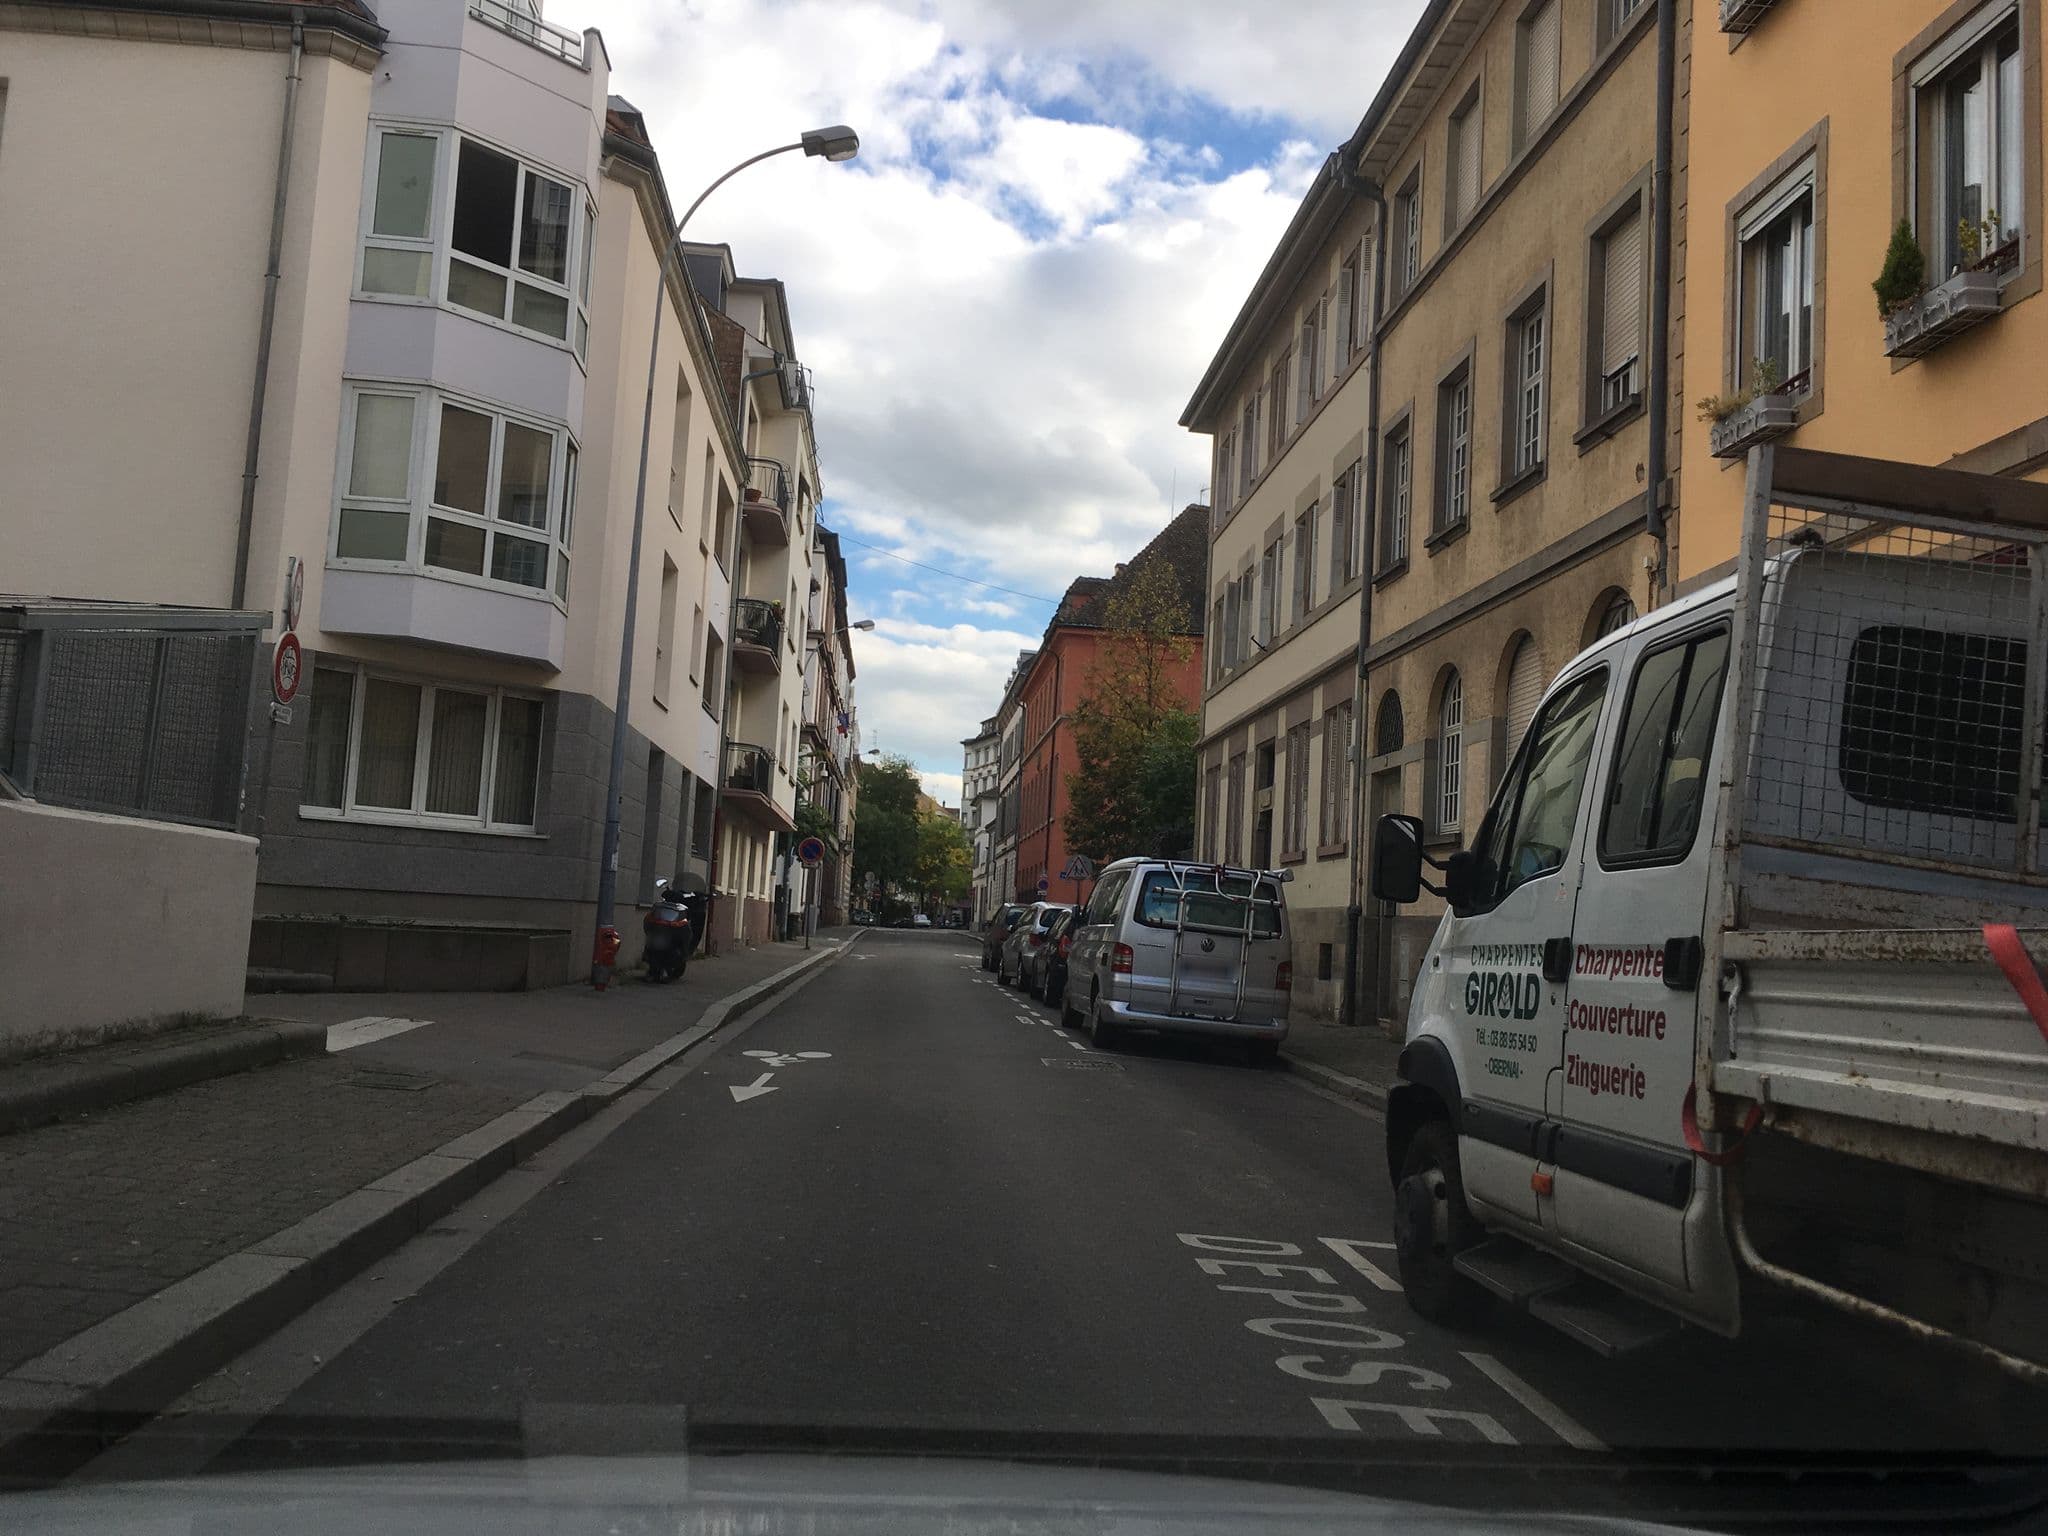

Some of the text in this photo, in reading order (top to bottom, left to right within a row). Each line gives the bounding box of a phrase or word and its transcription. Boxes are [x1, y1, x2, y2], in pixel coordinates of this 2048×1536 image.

[1471, 943, 1544, 967] CHARPENTES
[1575, 943, 1664, 981] Charpente
[1465, 970, 1541, 1020] GIROLD
[1569, 999, 1666, 1041] Couverture
[1566, 1053, 1646, 1100] Zinguerie
[1175, 1232, 1521, 1446] DEPOSE
